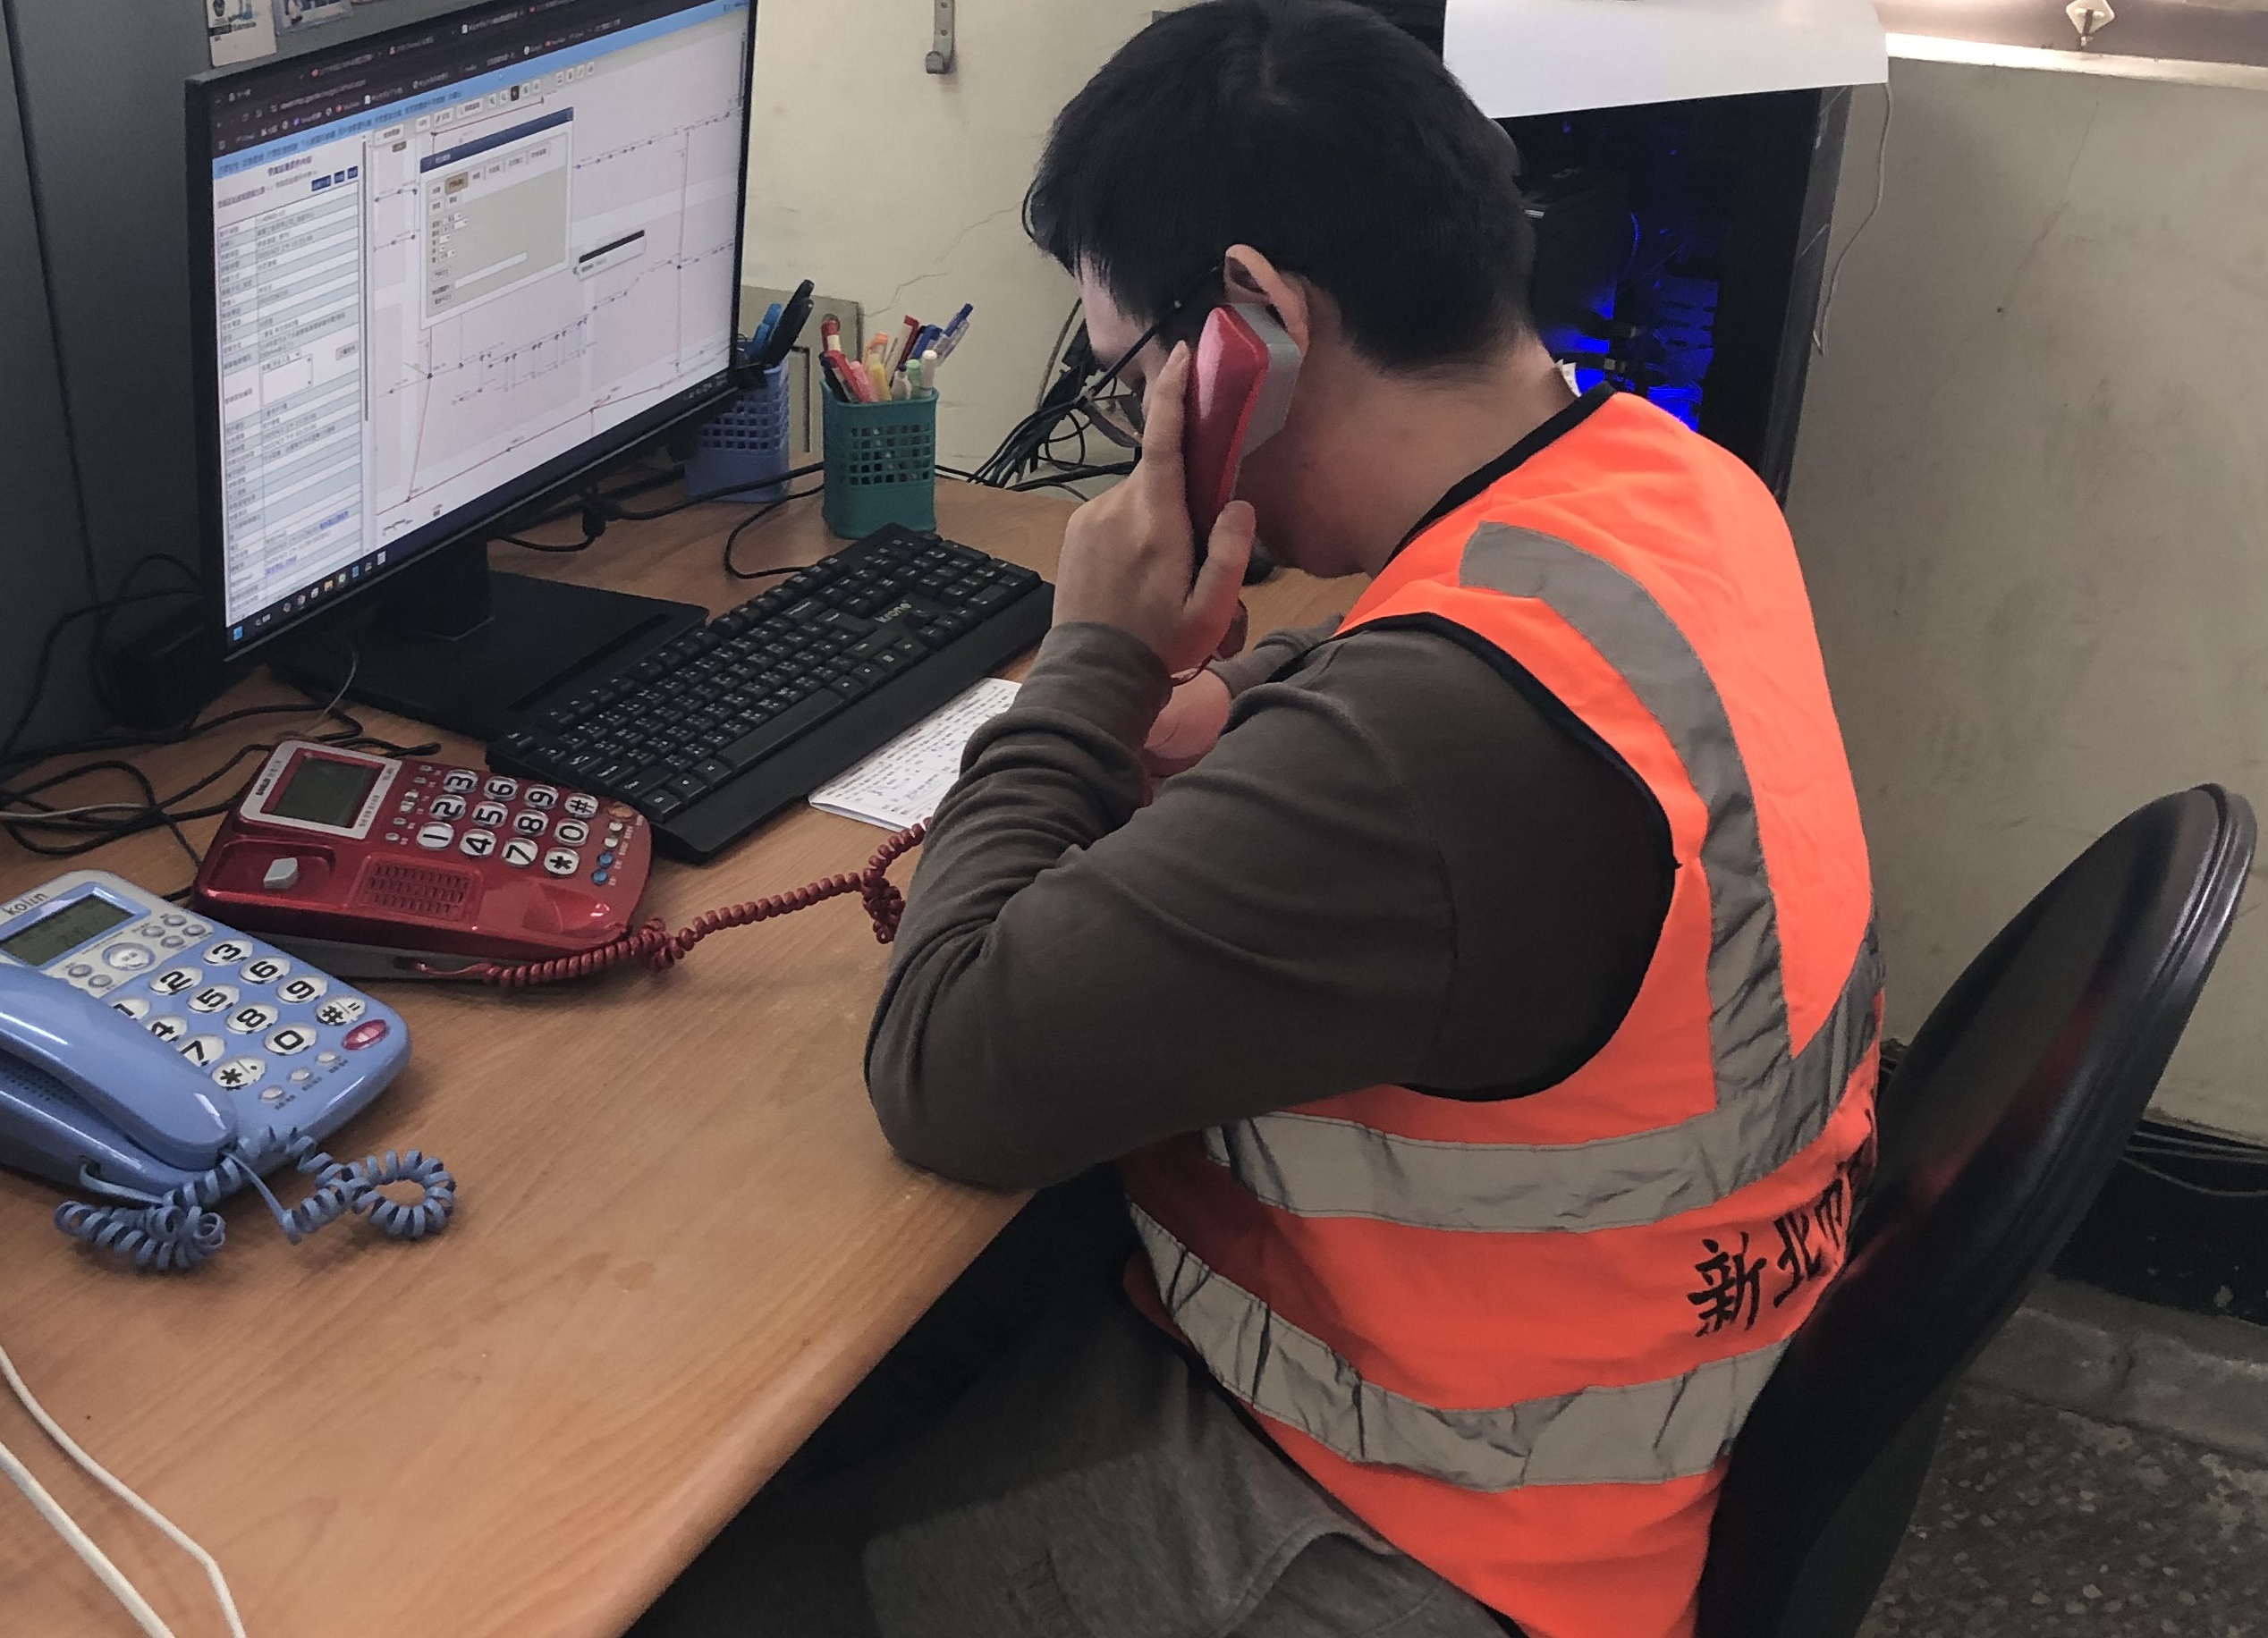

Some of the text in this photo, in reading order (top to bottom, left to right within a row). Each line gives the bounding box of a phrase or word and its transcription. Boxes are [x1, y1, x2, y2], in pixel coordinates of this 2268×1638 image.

[432, 801, 462, 816] 2
[447, 775, 474, 789] 3
[466, 781, 514, 854] 4 5 6
[559, 798, 595, 841] 0 #
[505, 790, 554, 864] 7 8 9
[2, 893, 49, 916] kolin
[160, 970, 192, 991] 2
[212, 943, 241, 961] 3
[197, 988, 228, 1009] 5
[250, 960, 278, 979] 6
[236, 1008, 267, 1028] 8
[285, 980, 316, 1000] 9
[274, 1030, 304, 1051] 0
[322, 1005, 343, 1024] #
